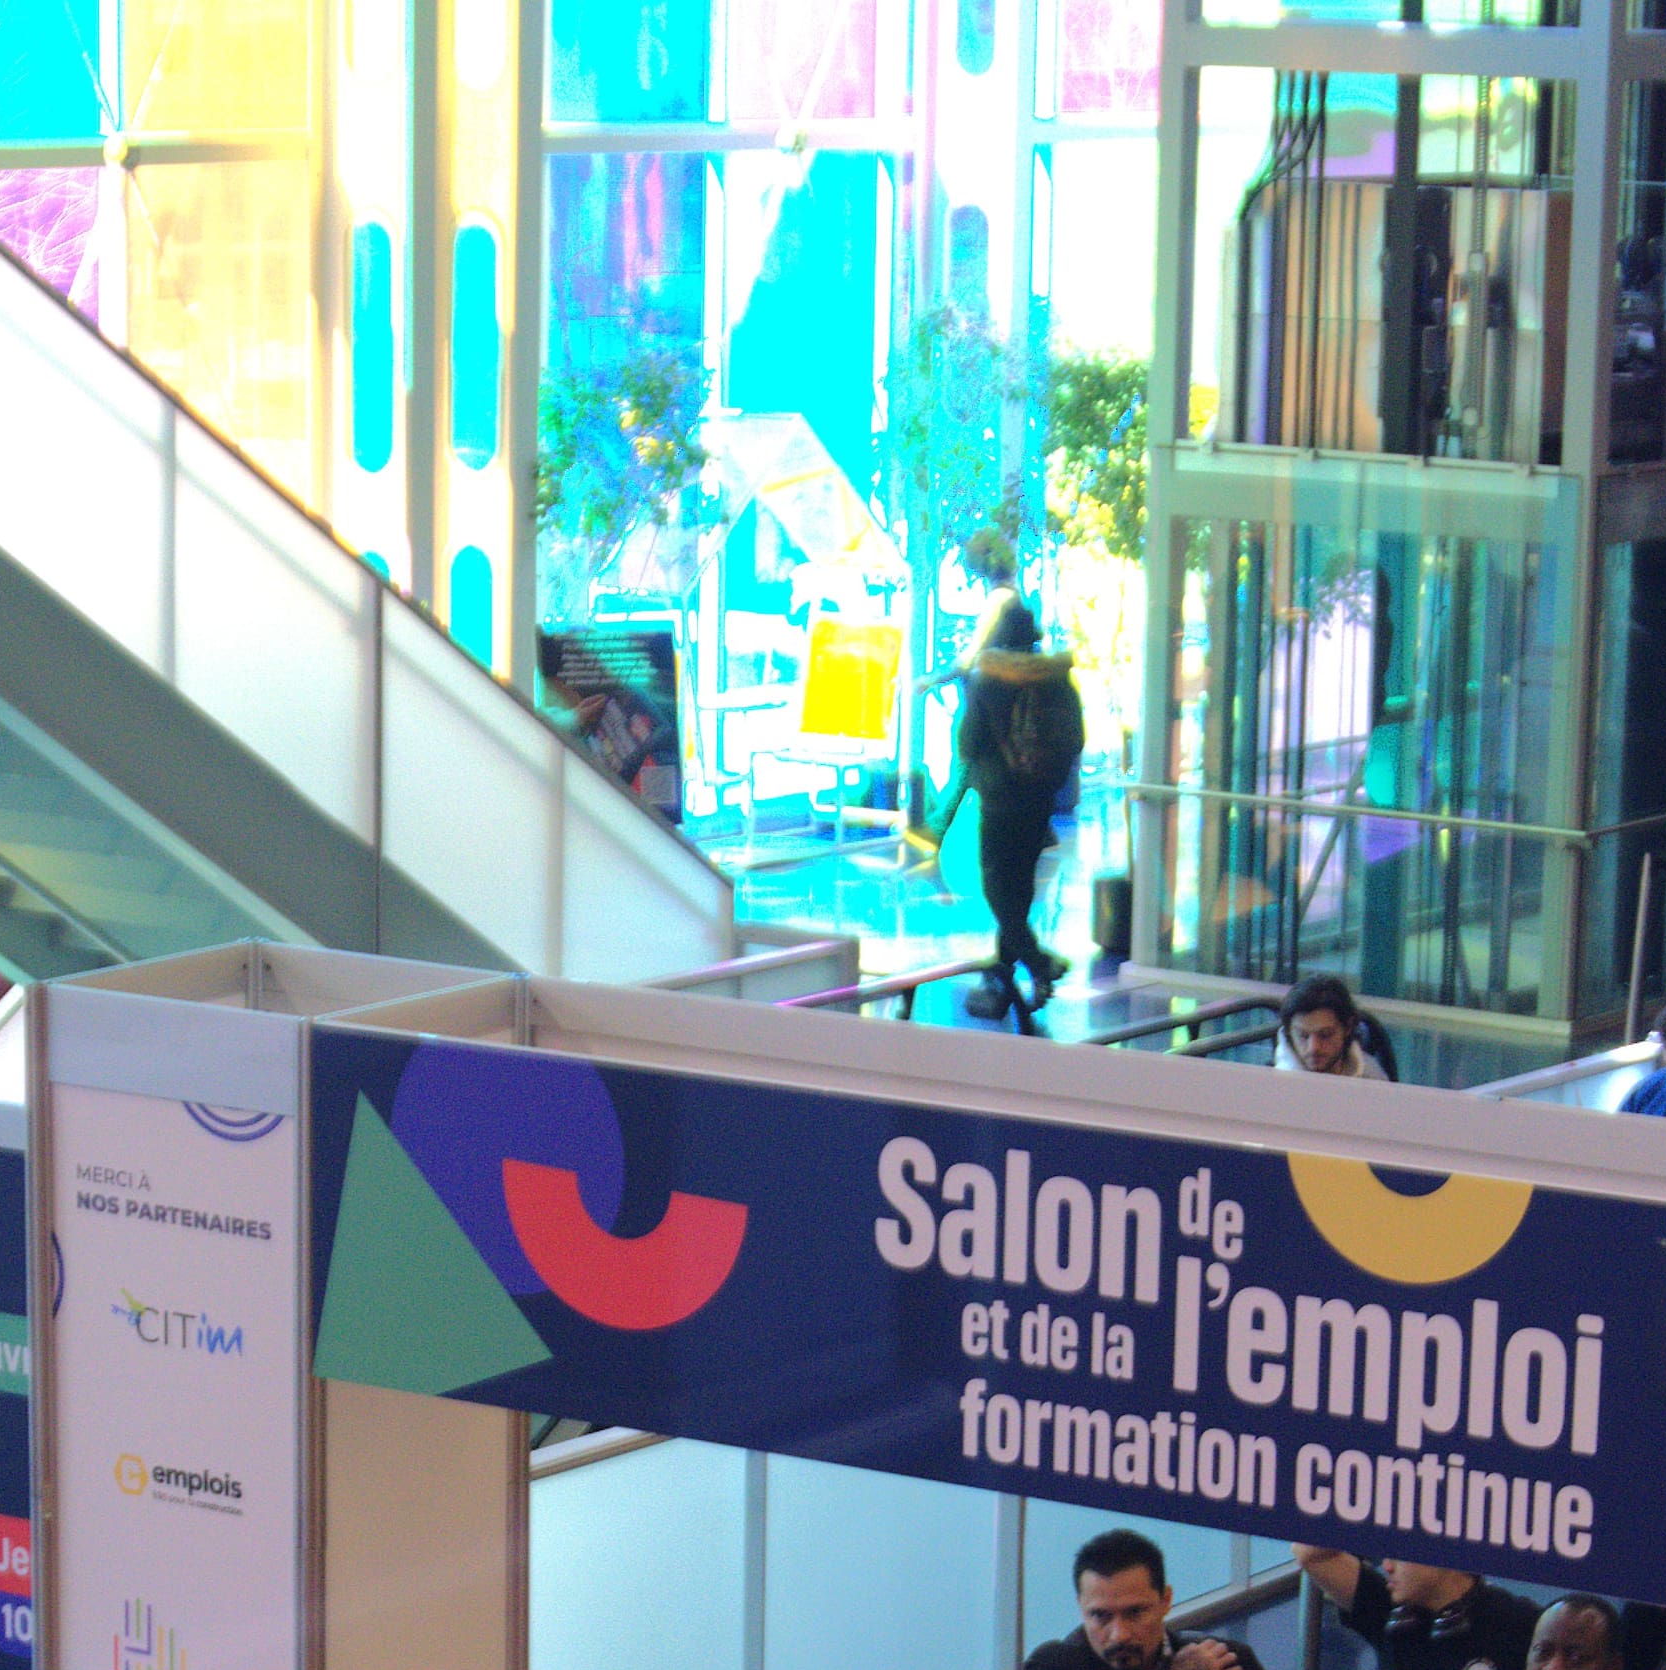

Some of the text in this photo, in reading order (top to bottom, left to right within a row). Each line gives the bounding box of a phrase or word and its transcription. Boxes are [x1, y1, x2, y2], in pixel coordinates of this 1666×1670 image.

[76, 1163, 151, 1191] MERCI À
[76, 1192, 272, 1240] NOS PARTENAIRES
[874, 1136, 1244, 1305] Salon de
[960, 1300, 1134, 1381] et de la
[152, 1465, 242, 1499] emplois
[960, 1379, 1594, 1559] formation continue
[1, 1603, 34, 1643] 10
